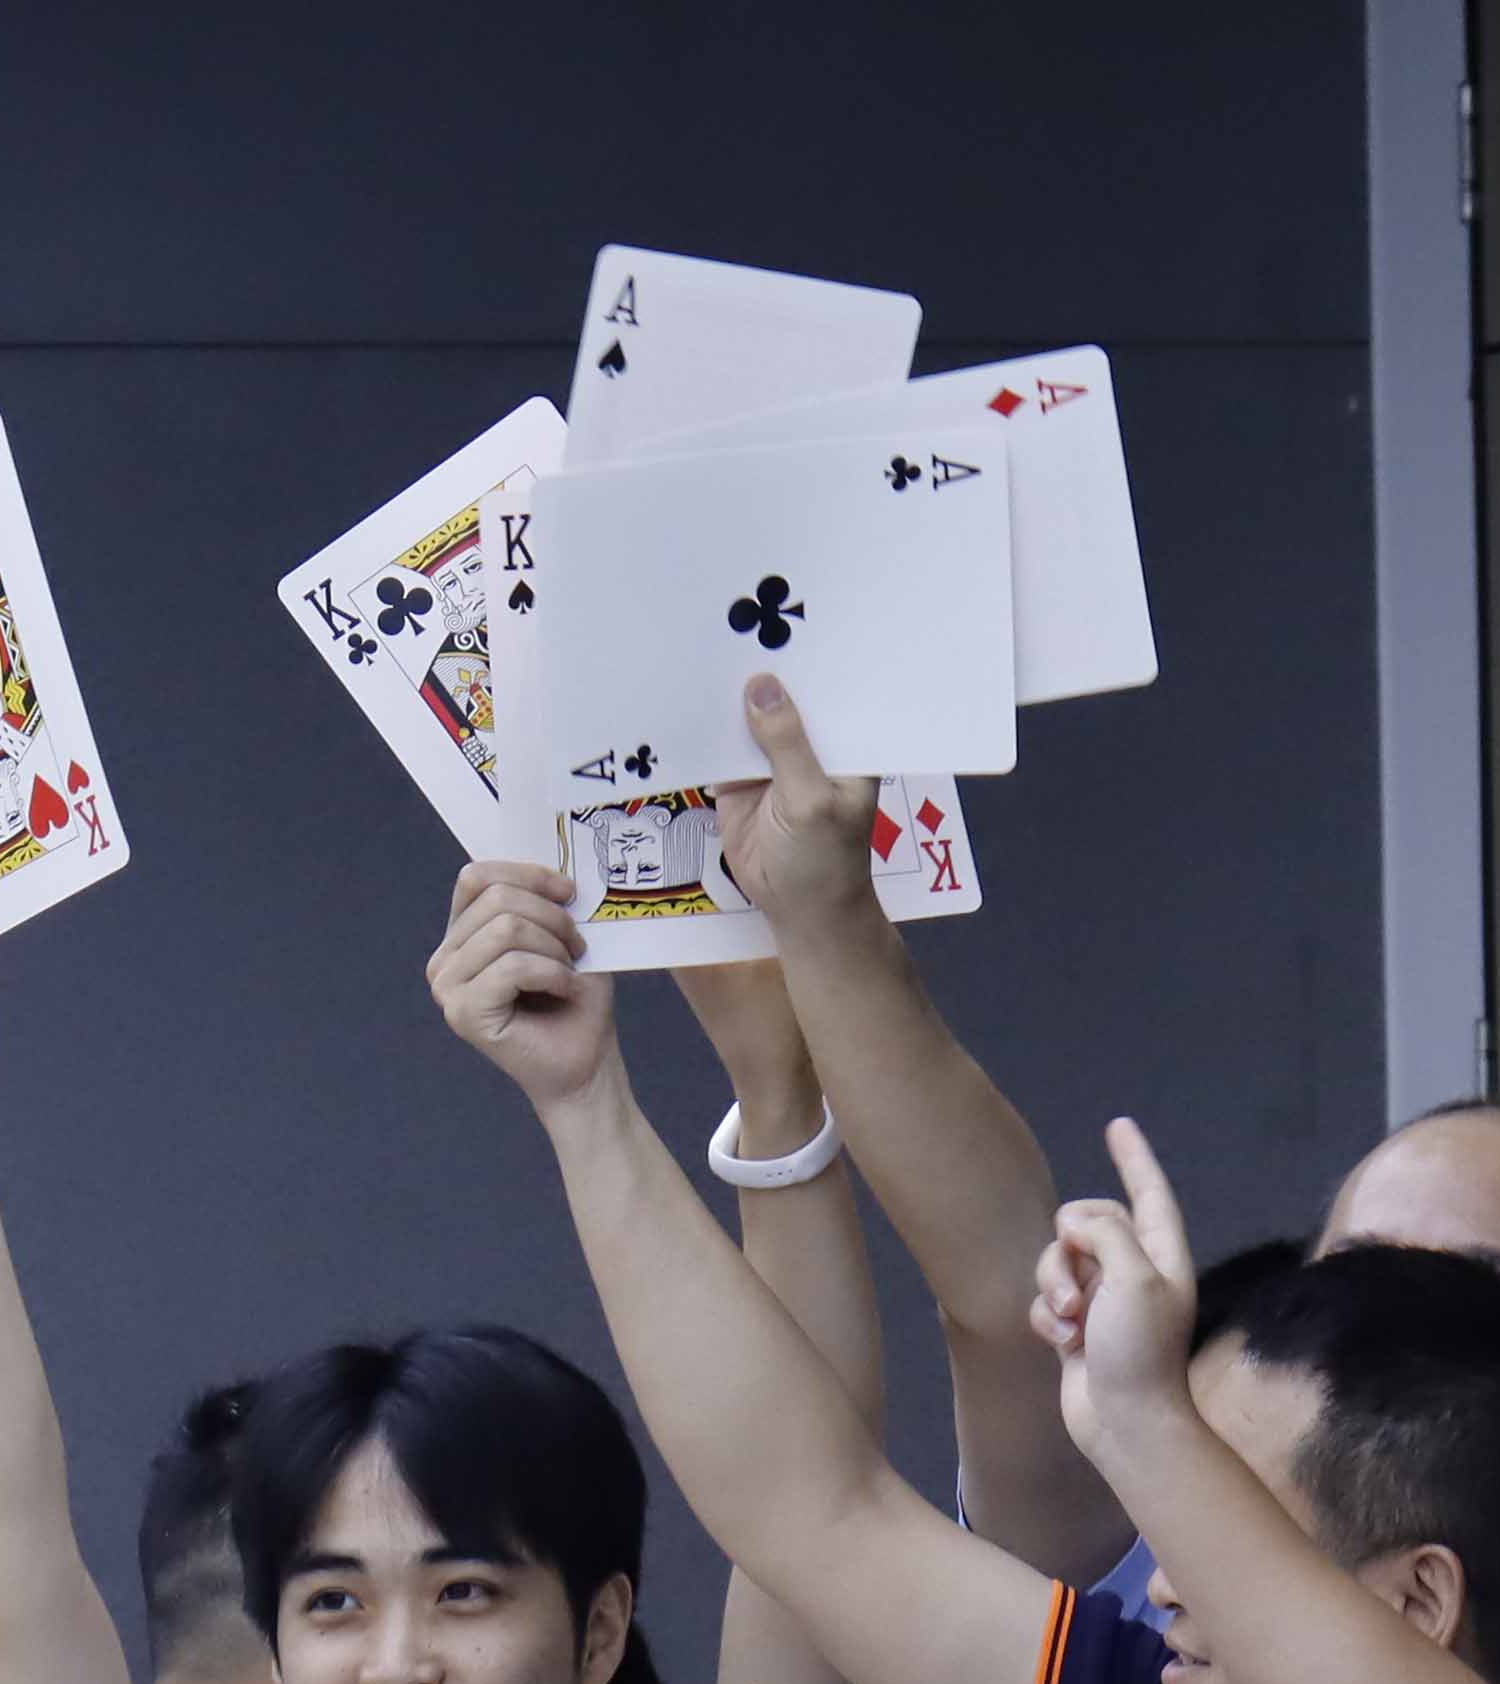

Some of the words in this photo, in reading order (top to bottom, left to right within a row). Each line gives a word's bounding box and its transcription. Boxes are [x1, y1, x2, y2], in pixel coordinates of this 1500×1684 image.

[604, 275, 639, 326] A
[1037, 379, 1088, 415] A
[933, 454, 981, 491] A
[501, 514, 535, 570] K
[304, 579, 360, 642] K
[571, 750, 616, 785] A
[74, 795, 111, 856] K
[919, 840, 961, 893] K
